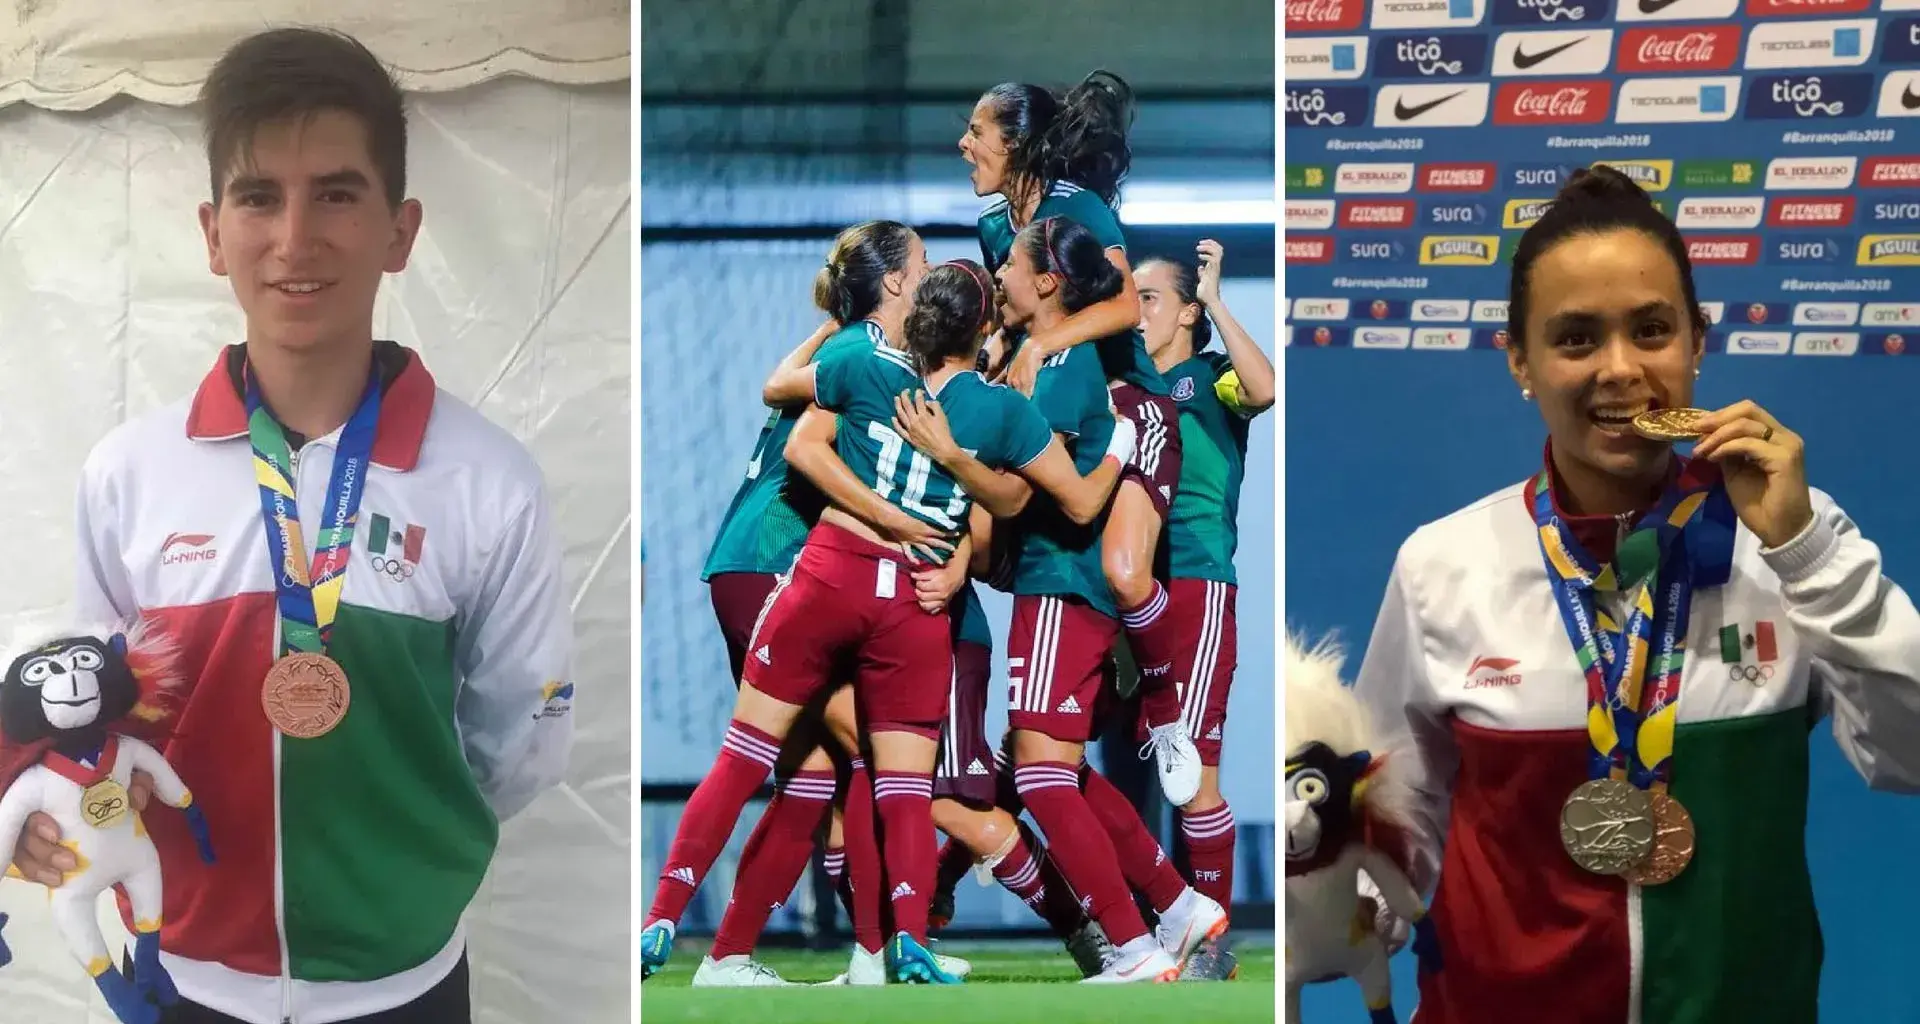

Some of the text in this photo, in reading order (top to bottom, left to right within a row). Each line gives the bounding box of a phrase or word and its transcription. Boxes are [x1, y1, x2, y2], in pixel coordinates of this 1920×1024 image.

[1546, 134, 1651, 149] #Barranquilla2018
[1782, 129, 1896, 145] #Barranquilla2018
[1326, 138, 1424, 152] #Barranquilla2018
[1358, 172, 1408, 180] HERALDO
[1516, 169, 1556, 185] sura
[1774, 165, 1848, 176] EL HERALDO
[1432, 207, 1473, 222] sura
[1684, 205, 1756, 215] EL HERALDO
[1874, 203, 1920, 219] sura
[1351, 243, 1390, 258] sura
[1780, 242, 1824, 259] sura
[1332, 277, 1428, 290] #Barranquilla2018
[1781, 278, 1892, 293] #Barranquilla2018
[327, 457, 359, 560] BARRANQUILLA2018
[162, 549, 217, 566] LI-NING
[1143, 662, 1171, 677] FMF
[1195, 870, 1222, 882] FMF
